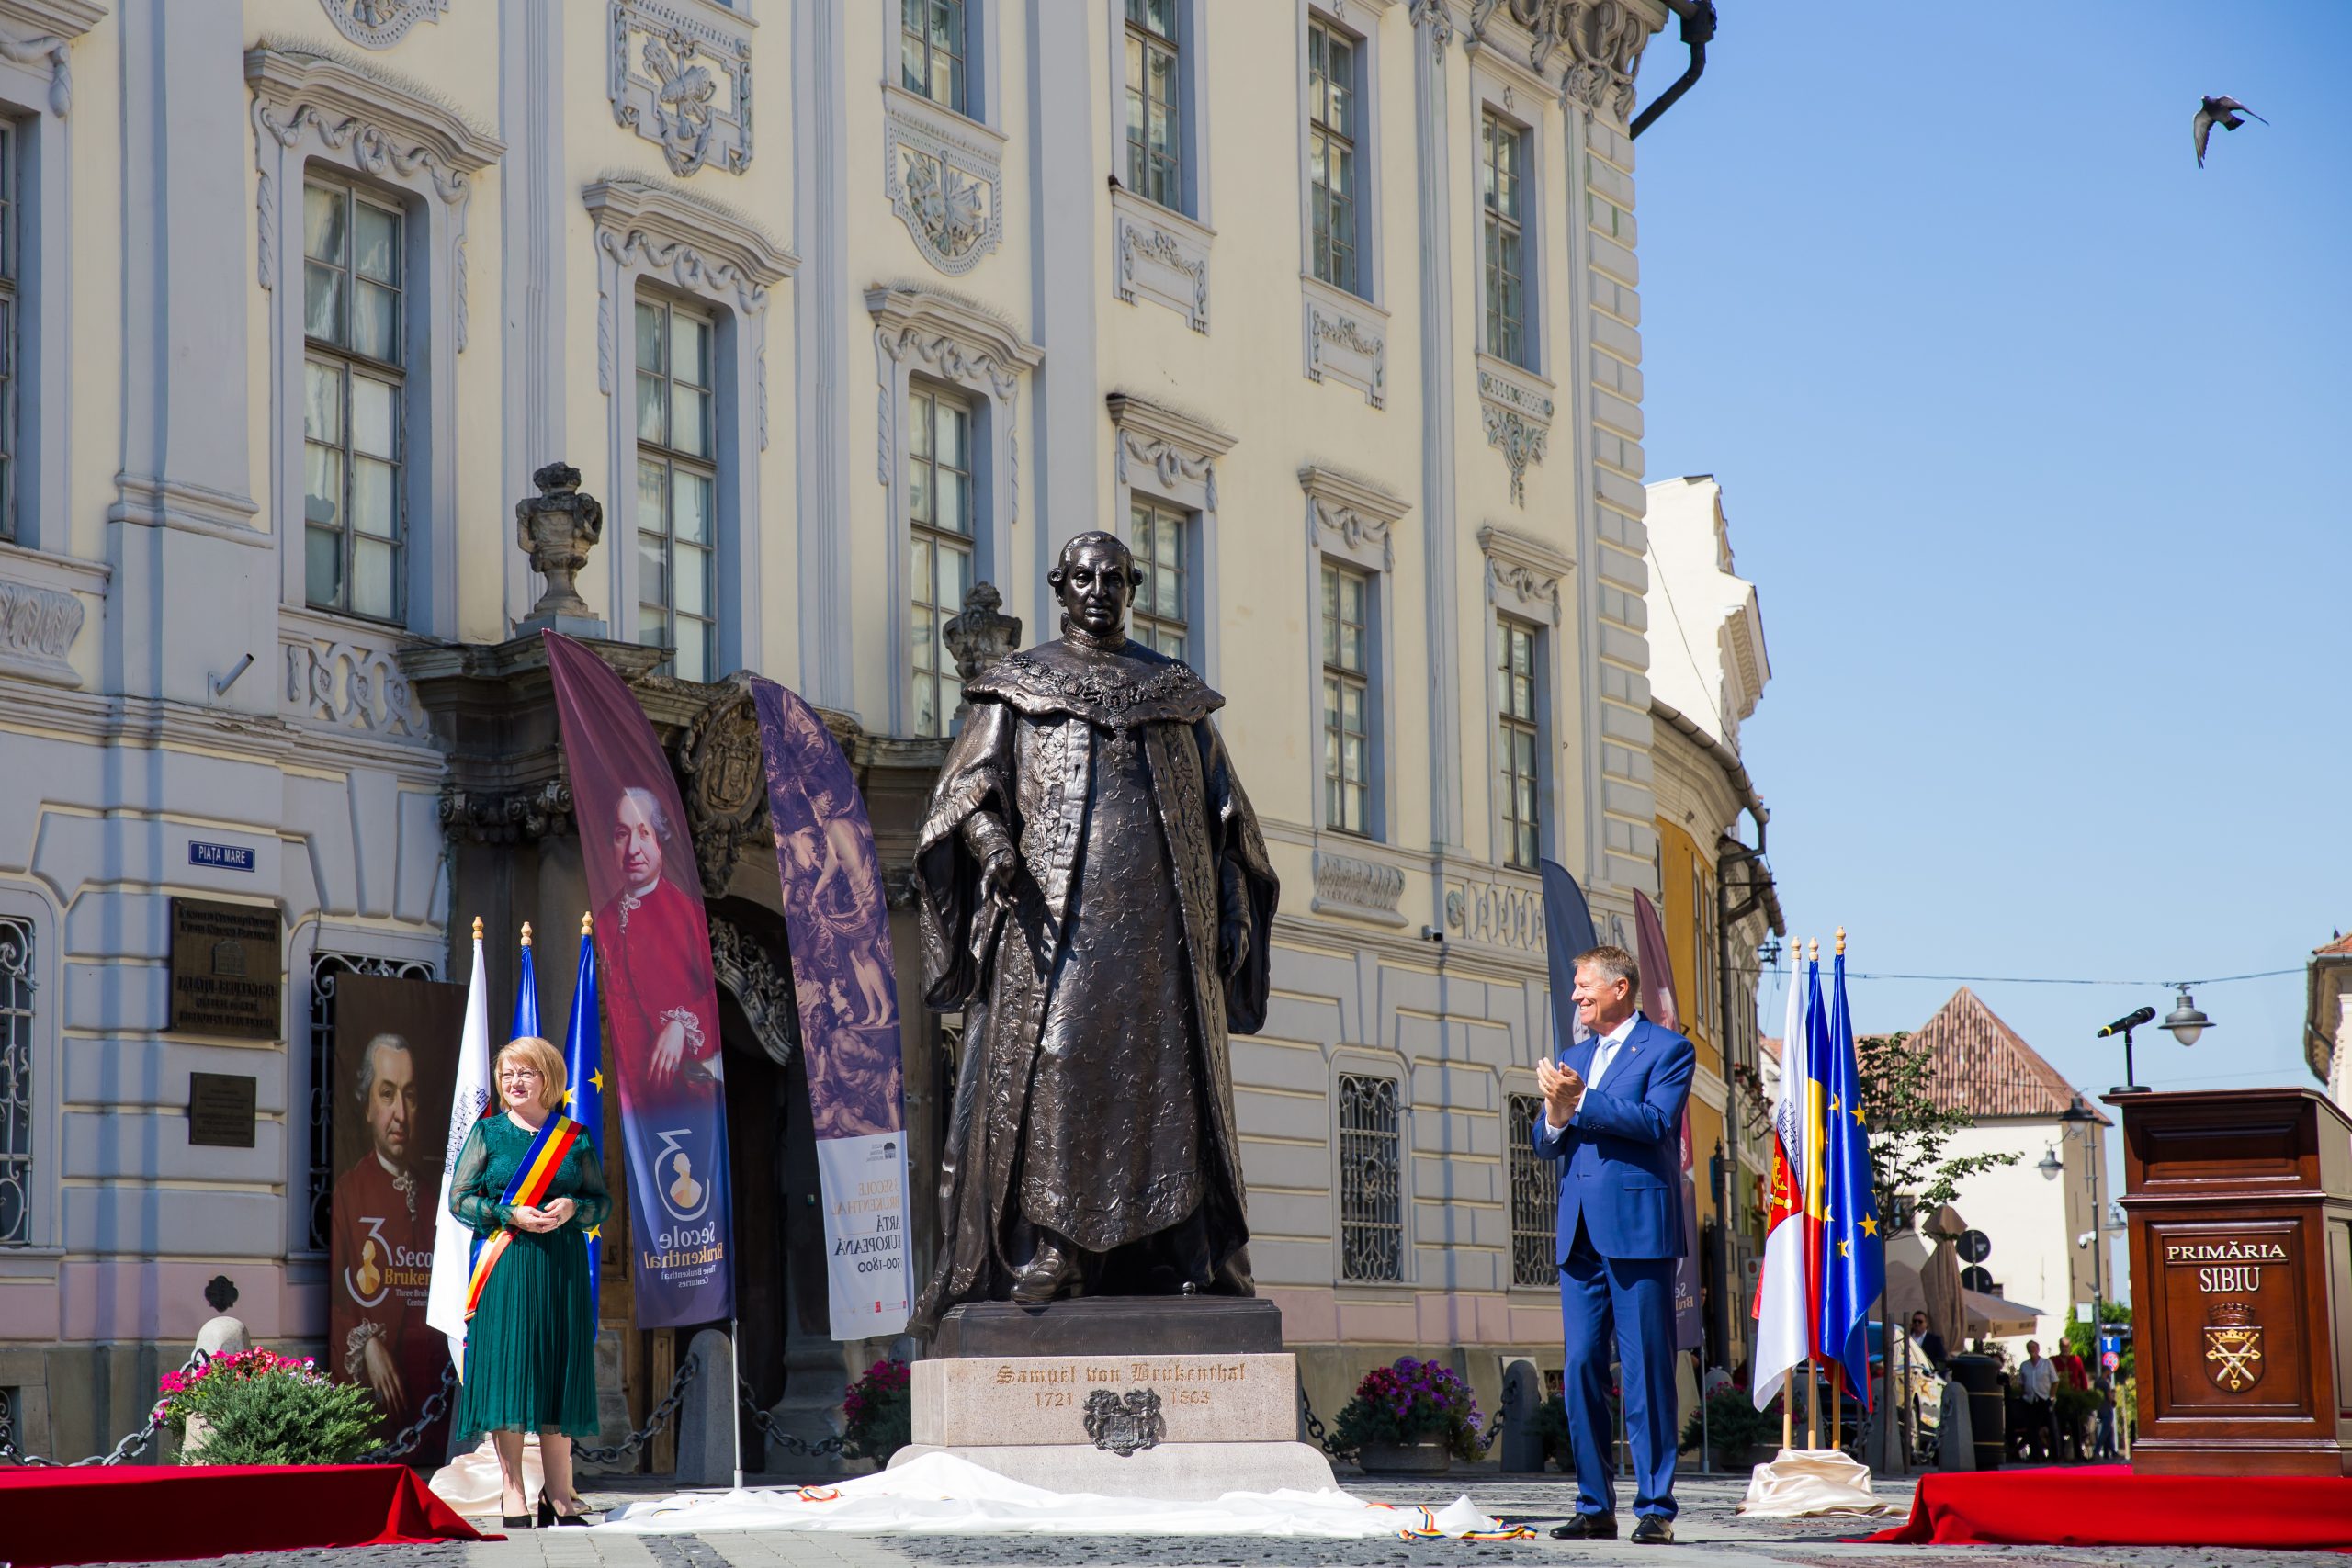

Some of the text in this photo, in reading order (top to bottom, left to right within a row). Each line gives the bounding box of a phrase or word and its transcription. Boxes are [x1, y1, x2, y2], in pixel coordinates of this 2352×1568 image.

[198, 845, 246, 864] PIAȚA MARE
[395, 1246, 433, 1268] Seco
[2166, 1240, 2286, 1260] PRIMĂRIA
[2199, 1267, 2260, 1292] SIBIU
[395, 1288, 413, 1297] Three
[997, 1362, 1245, 1384] Samuel von Brukenthal
[1035, 1390, 1211, 1407] 1721 1803
